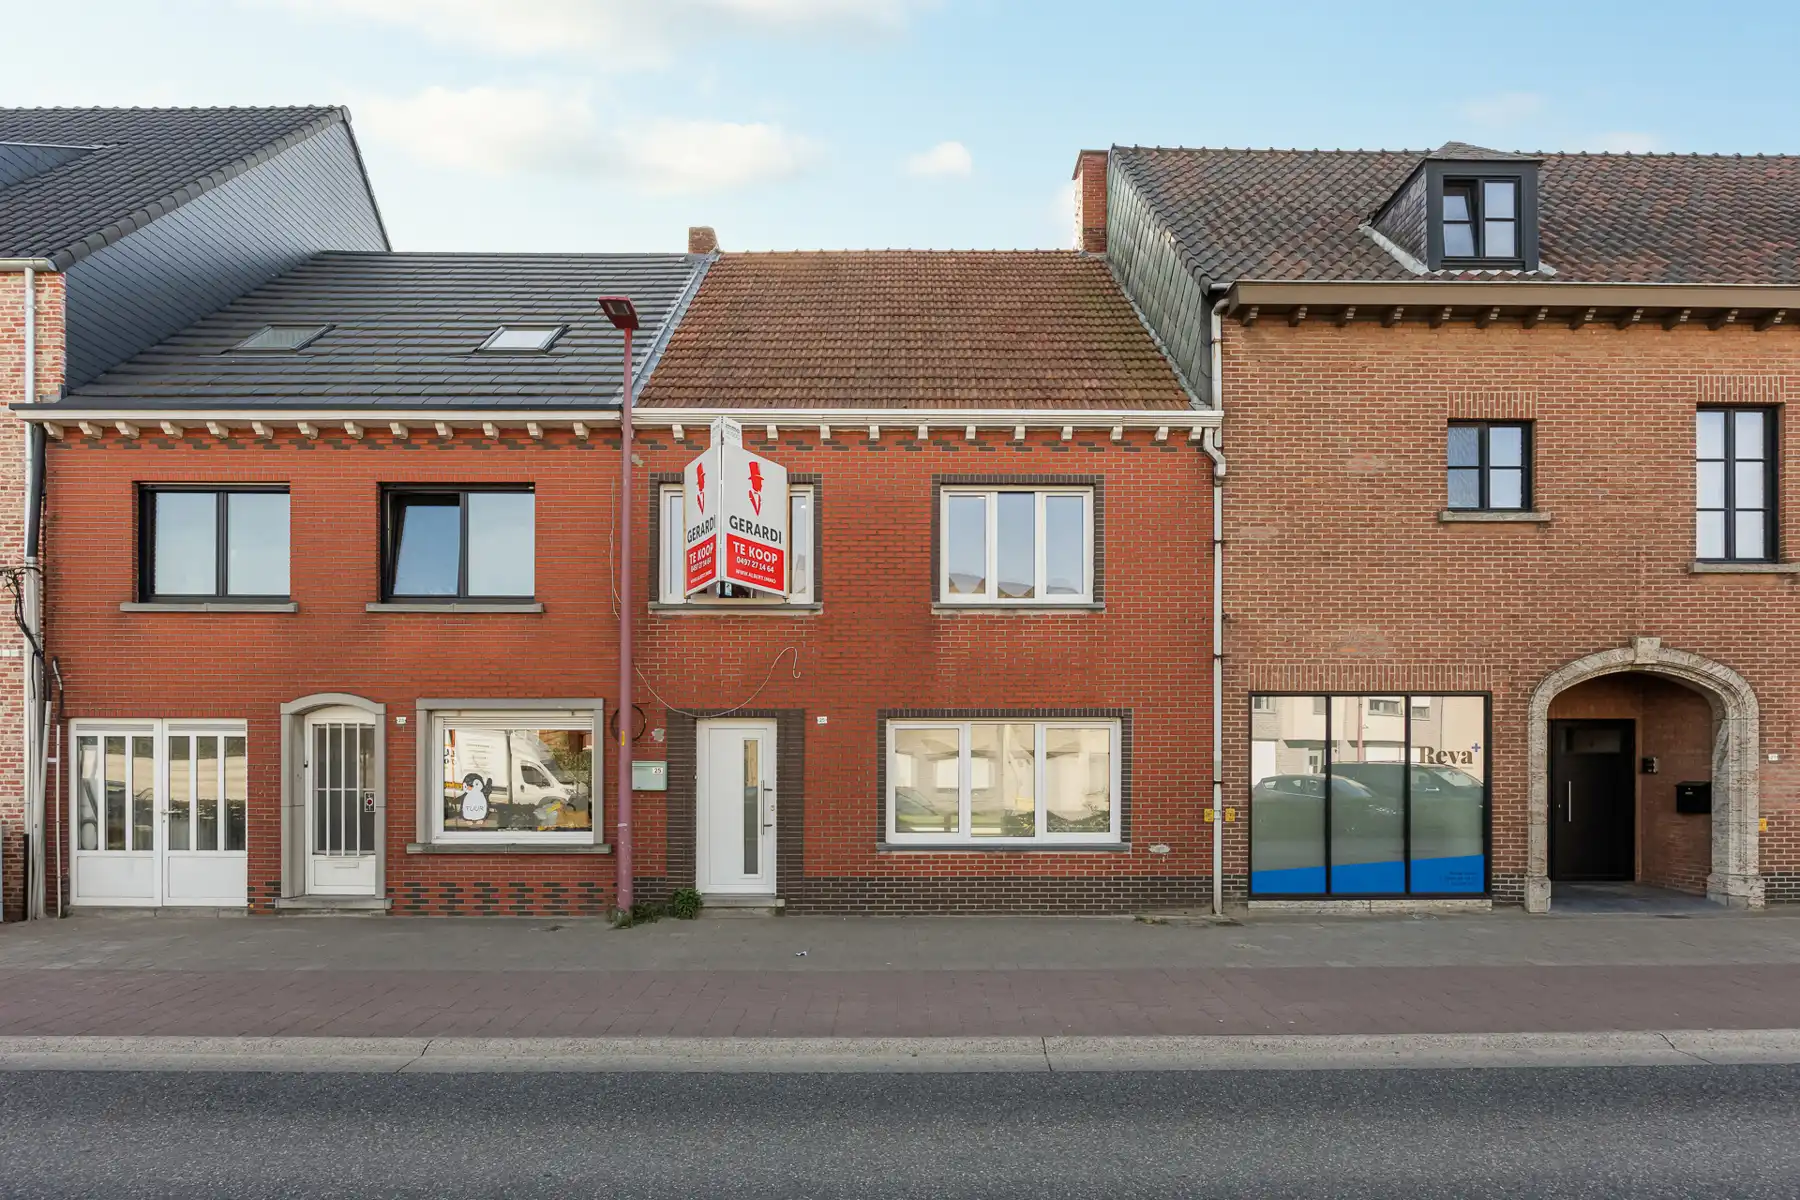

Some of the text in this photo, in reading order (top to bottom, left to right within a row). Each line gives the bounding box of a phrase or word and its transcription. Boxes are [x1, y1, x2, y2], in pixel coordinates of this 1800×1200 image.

[687, 514, 716, 543] GERARDI
[729, 514, 782, 545] GERARDI
[689, 542, 714, 565] TE KOOP
[733, 541, 778, 565] TE KOOP
[736, 556, 775, 573] 0497 27 14 64
